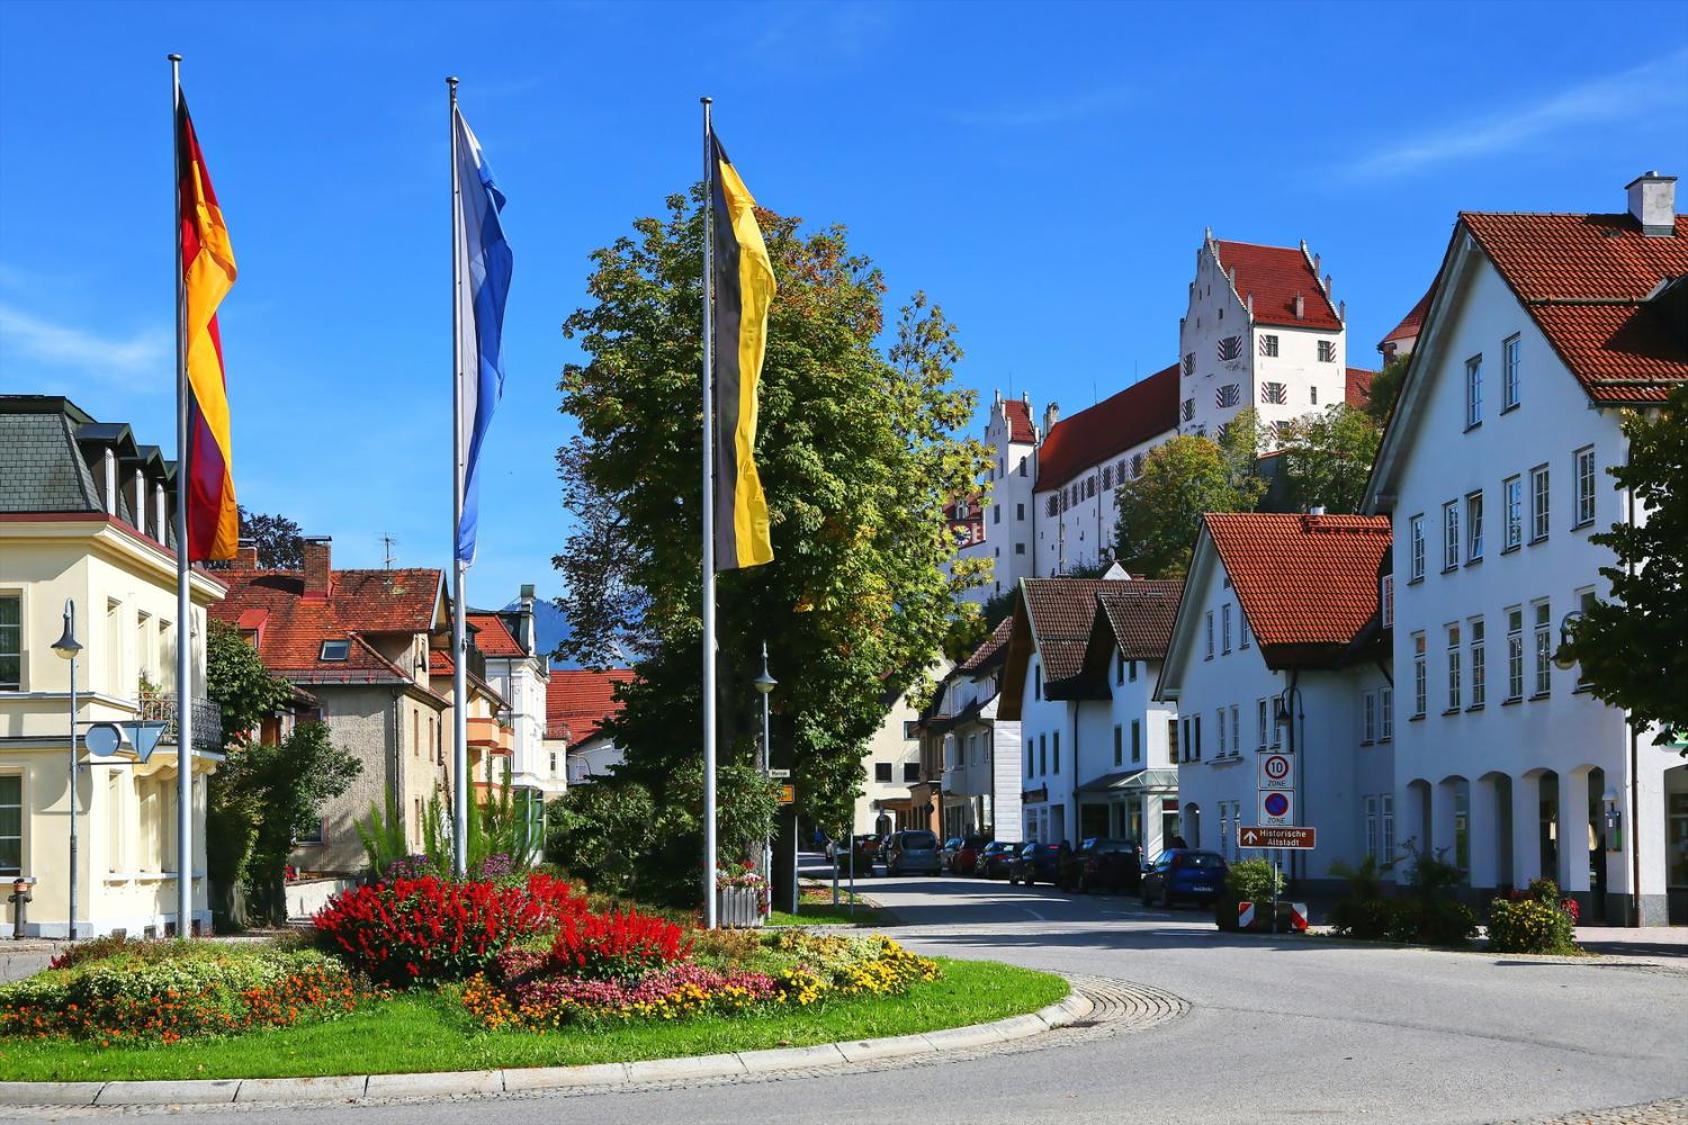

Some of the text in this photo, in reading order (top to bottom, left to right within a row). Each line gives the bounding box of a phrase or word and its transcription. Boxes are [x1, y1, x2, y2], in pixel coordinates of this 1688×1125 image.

[1271, 762, 1283, 773] 10
[1259, 829, 1307, 838] Historische
[1267, 838, 1300, 846] Altstadt
